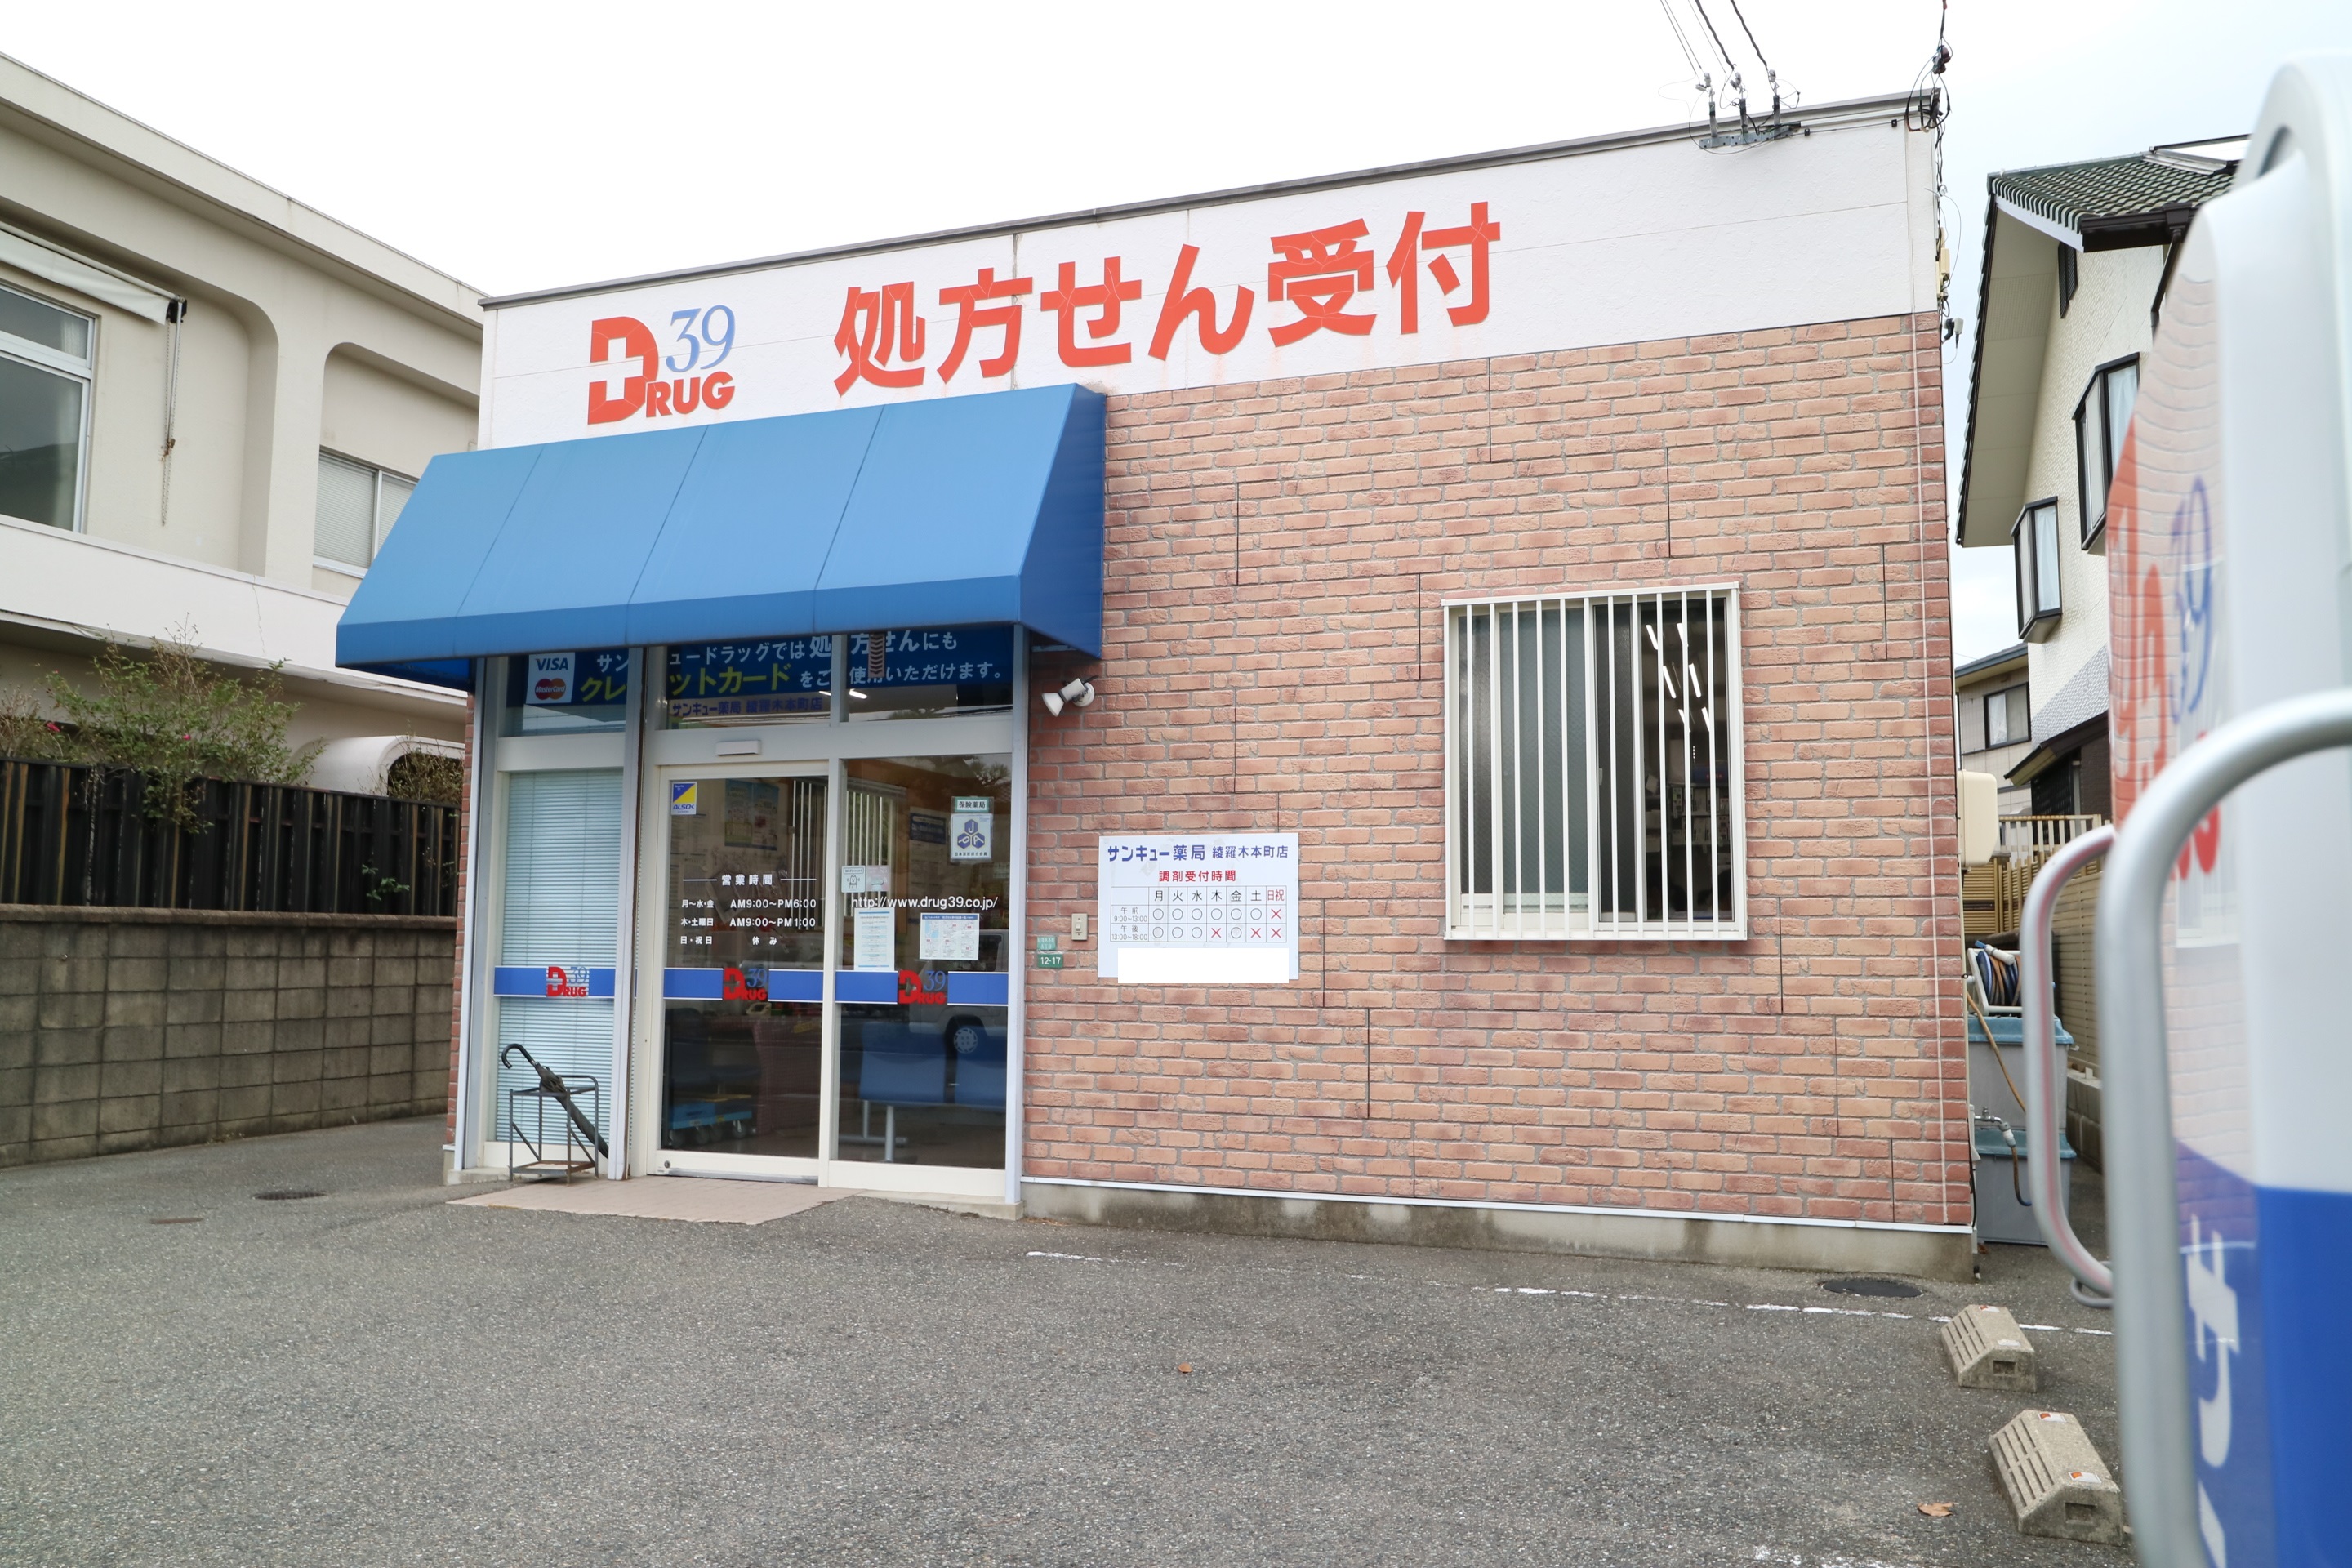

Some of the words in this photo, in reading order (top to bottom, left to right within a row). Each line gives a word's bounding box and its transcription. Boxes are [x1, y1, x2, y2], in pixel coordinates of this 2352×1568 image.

[833, 201, 1500, 398] 処方せん受付
[665, 305, 737, 373] 39
[586, 316, 736, 425] DRUG
[535, 657, 569, 671] VISA
[672, 700, 742, 716] サンキュー薬局
[1107, 844, 1205, 862] サンキュー薬局
[1212, 845, 1289, 859] 綾羅木本町店
[721, 874, 773, 886] 営業時間
[1159, 870, 1236, 882] 調剤受付時間
[851, 896, 998, 911] http://www.drug39.co.jp/
[1154, 890, 1164, 902] 月
[1172, 890, 1183, 902] 火
[1192, 890, 1203, 902] 水
[1210, 890, 1223, 902] 木
[1230, 890, 1242, 902] 金
[1250, 890, 1262, 902] 土
[1267, 889, 1285, 902] 日祝
[1120, 906, 1139, 915] 午前
[1120, 924, 1139, 933] 午後
[752, 936, 777, 946] 休み
[547, 966, 587, 997] DRUG
[569, 966, 588, 983] 39
[746, 968, 768, 988] 39
[923, 970, 947, 991] 39
[898, 969, 947, 1004] DRUG
